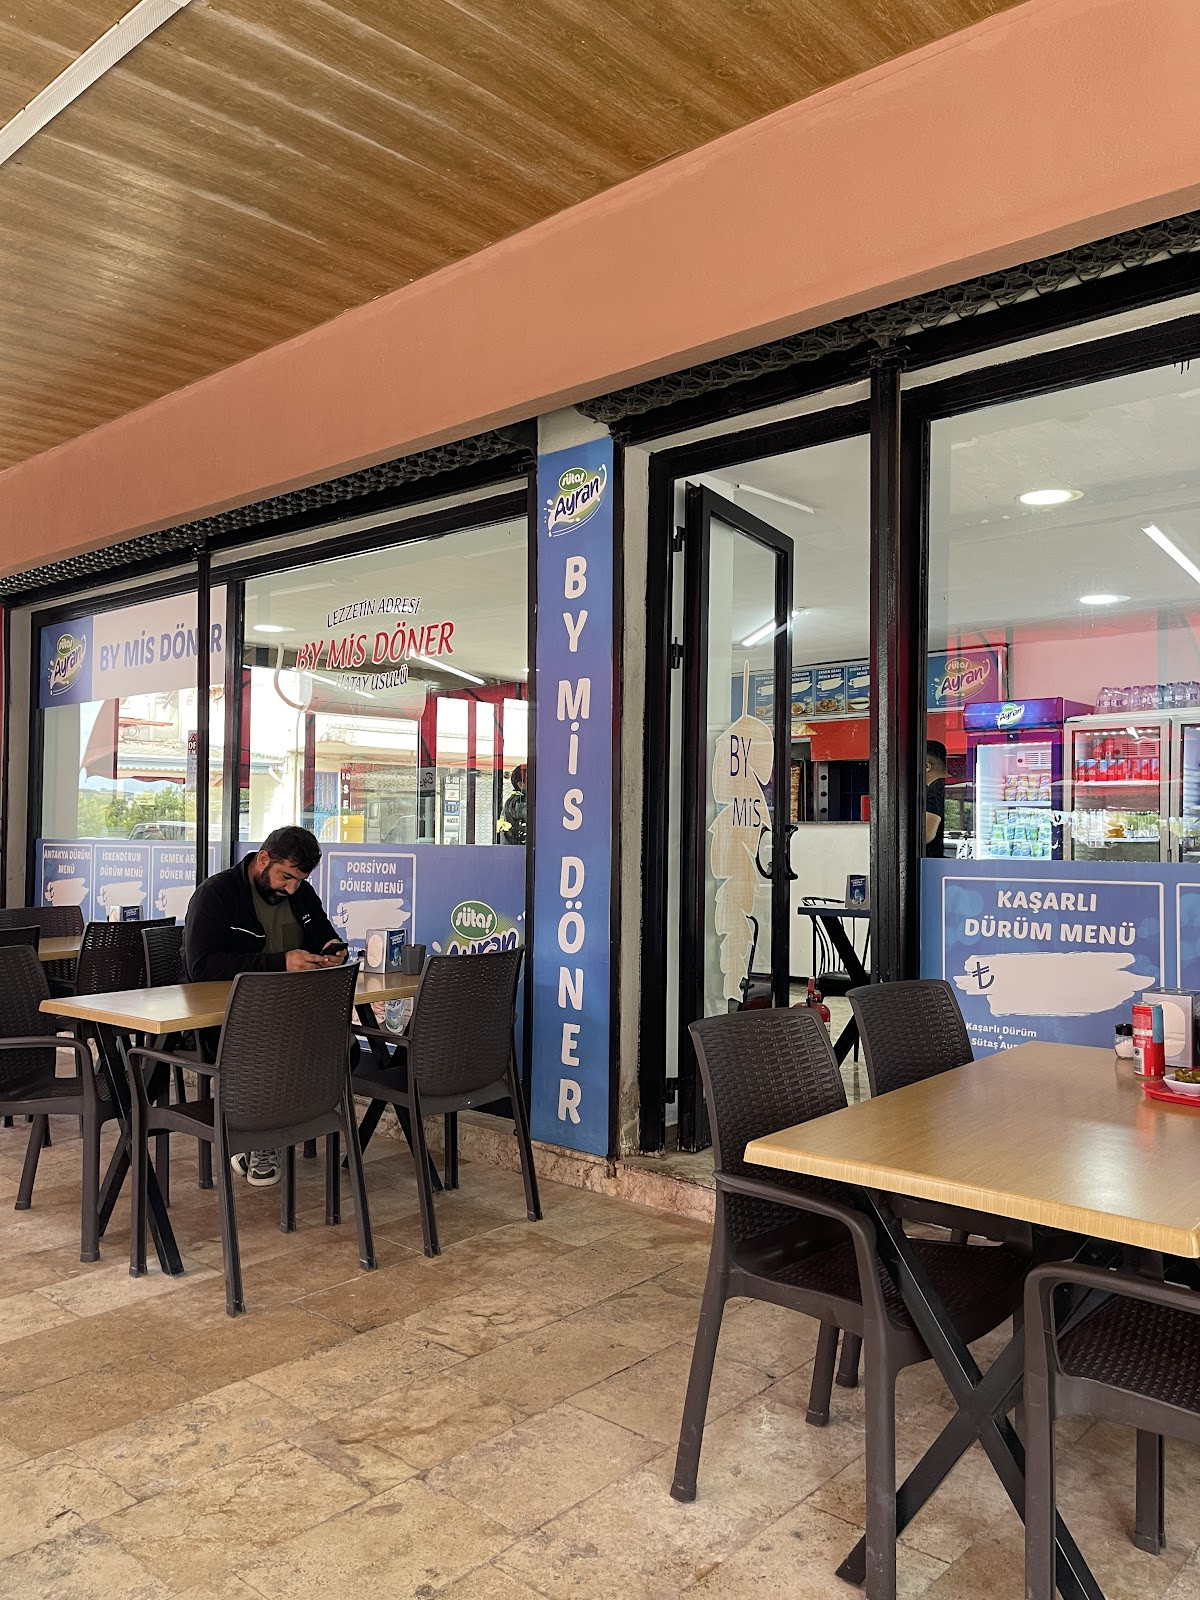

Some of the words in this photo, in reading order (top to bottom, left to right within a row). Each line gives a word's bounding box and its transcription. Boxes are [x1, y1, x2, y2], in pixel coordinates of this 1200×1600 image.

[554, 477, 600, 522] Ayran
[327, 599, 376, 628] LEZZETİN
[377, 597, 421, 615] ADRESİ
[100, 643, 120, 672] BY
[123, 630, 155, 668] MİS
[159, 623, 222, 662] DÖNR
[296, 640, 324, 671] BY
[326, 633, 367, 670] MİS
[372, 621, 455, 664] DÖNER
[53, 645, 84, 681] Ayran
[335, 674, 370, 691] HATAY
[371, 664, 409, 691] USULÜ
[941, 666, 983, 694] Ayran
[999, 706, 1023, 721] Ayran
[730, 734, 752, 778] BY
[44, 850, 69, 860] ANTAKYA
[69, 848, 92, 860] DÜRÜM
[102, 850, 142, 862] İSKENDERUN
[160, 853, 184, 864] EKMEK
[58, 863, 75, 875] MENÜ
[100, 865, 123, 877] DÜRÜM
[124, 867, 144, 878] MENÜ
[160, 868, 184, 880] DÖNER
[346, 859, 397, 875] PORSİYON
[339, 877, 372, 892] DÖNER
[374, 879, 404, 894] MENÜ
[997, 890, 1097, 914] KAŞARLI
[965, 915, 1052, 941] DÜRÜM
[1060, 921, 1136, 946] MENÜ
[557, 856, 586, 1126] DÖNER
[966, 1022, 1000, 1034] Kaşarlı
[1002, 1026, 1037, 1038] Dürüm
[971, 1037, 998, 1050] Sütaş
